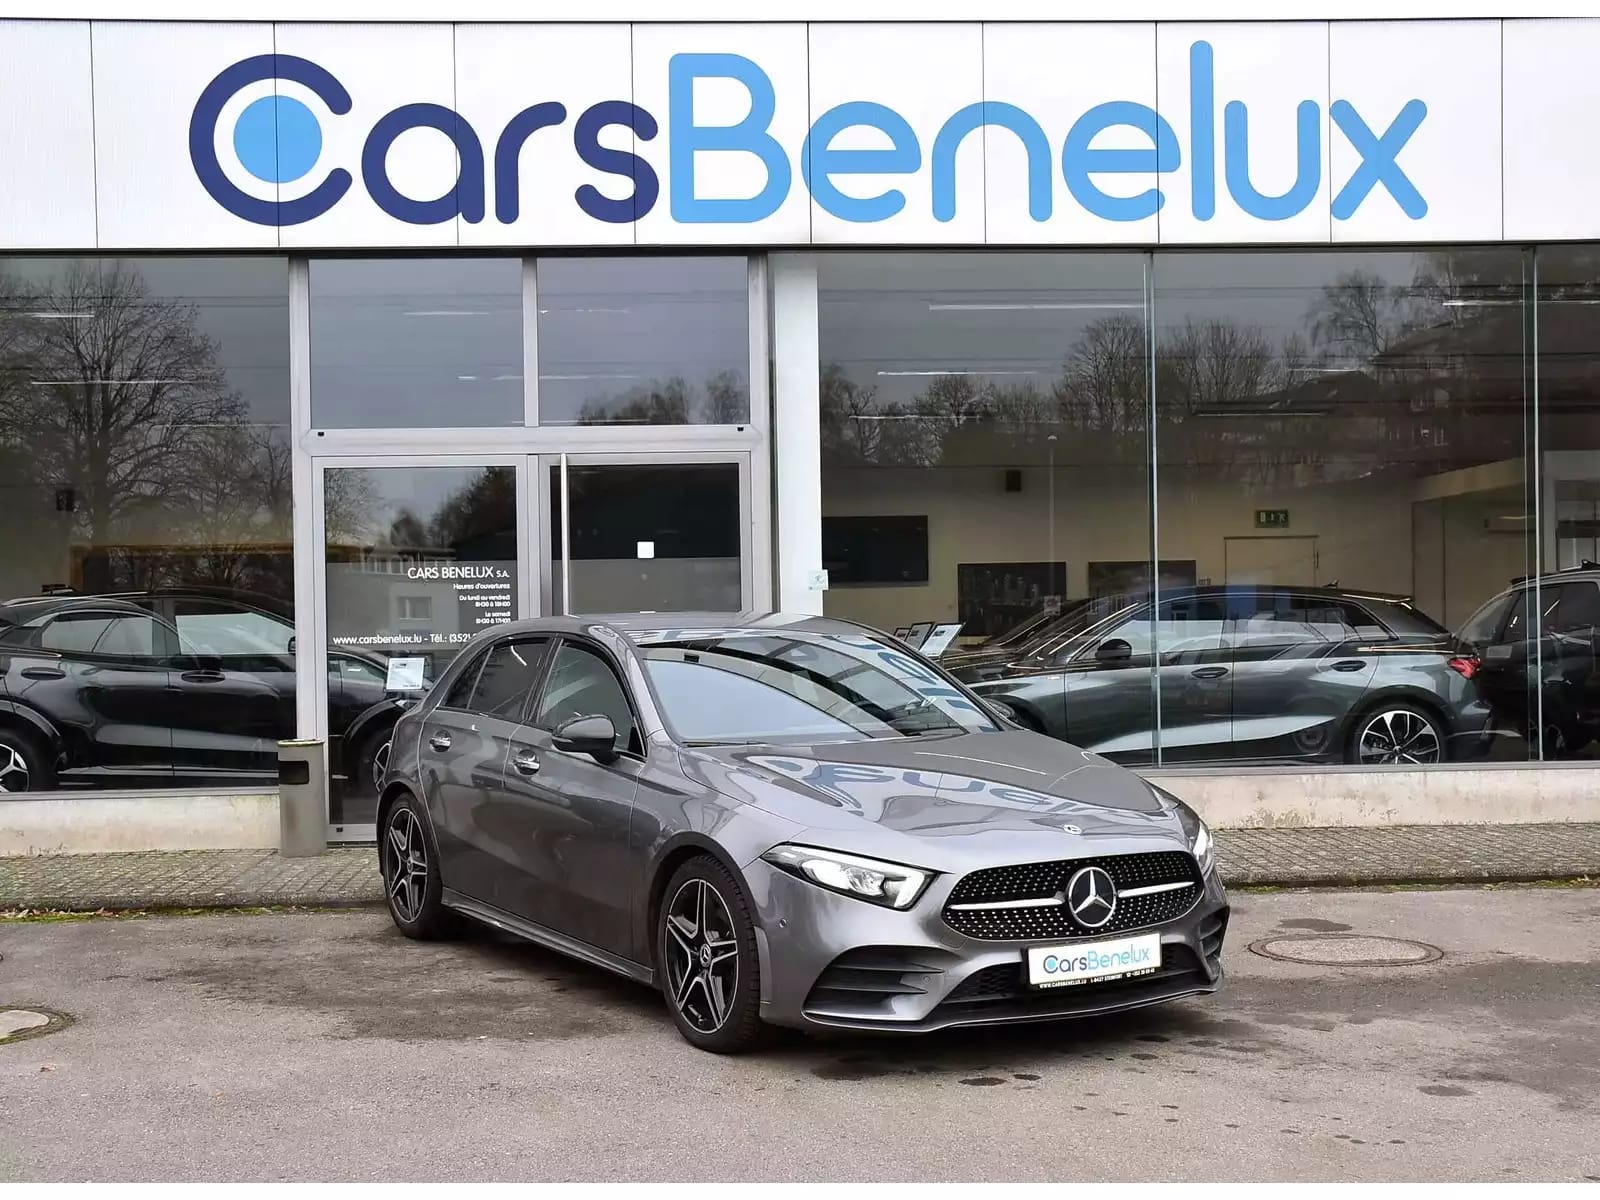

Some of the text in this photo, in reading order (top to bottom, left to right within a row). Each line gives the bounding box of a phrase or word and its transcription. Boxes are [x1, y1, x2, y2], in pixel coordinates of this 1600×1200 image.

[188, 39, 1429, 227] CarsBenelux
[407, 566, 510, 579] CARS BENELUX S.A.
[333, 634, 422, 645] www.carsbenelux.lu
[430, 633, 447, 643] Tél.:
[1043, 943, 1150, 974] CarsBenelux
